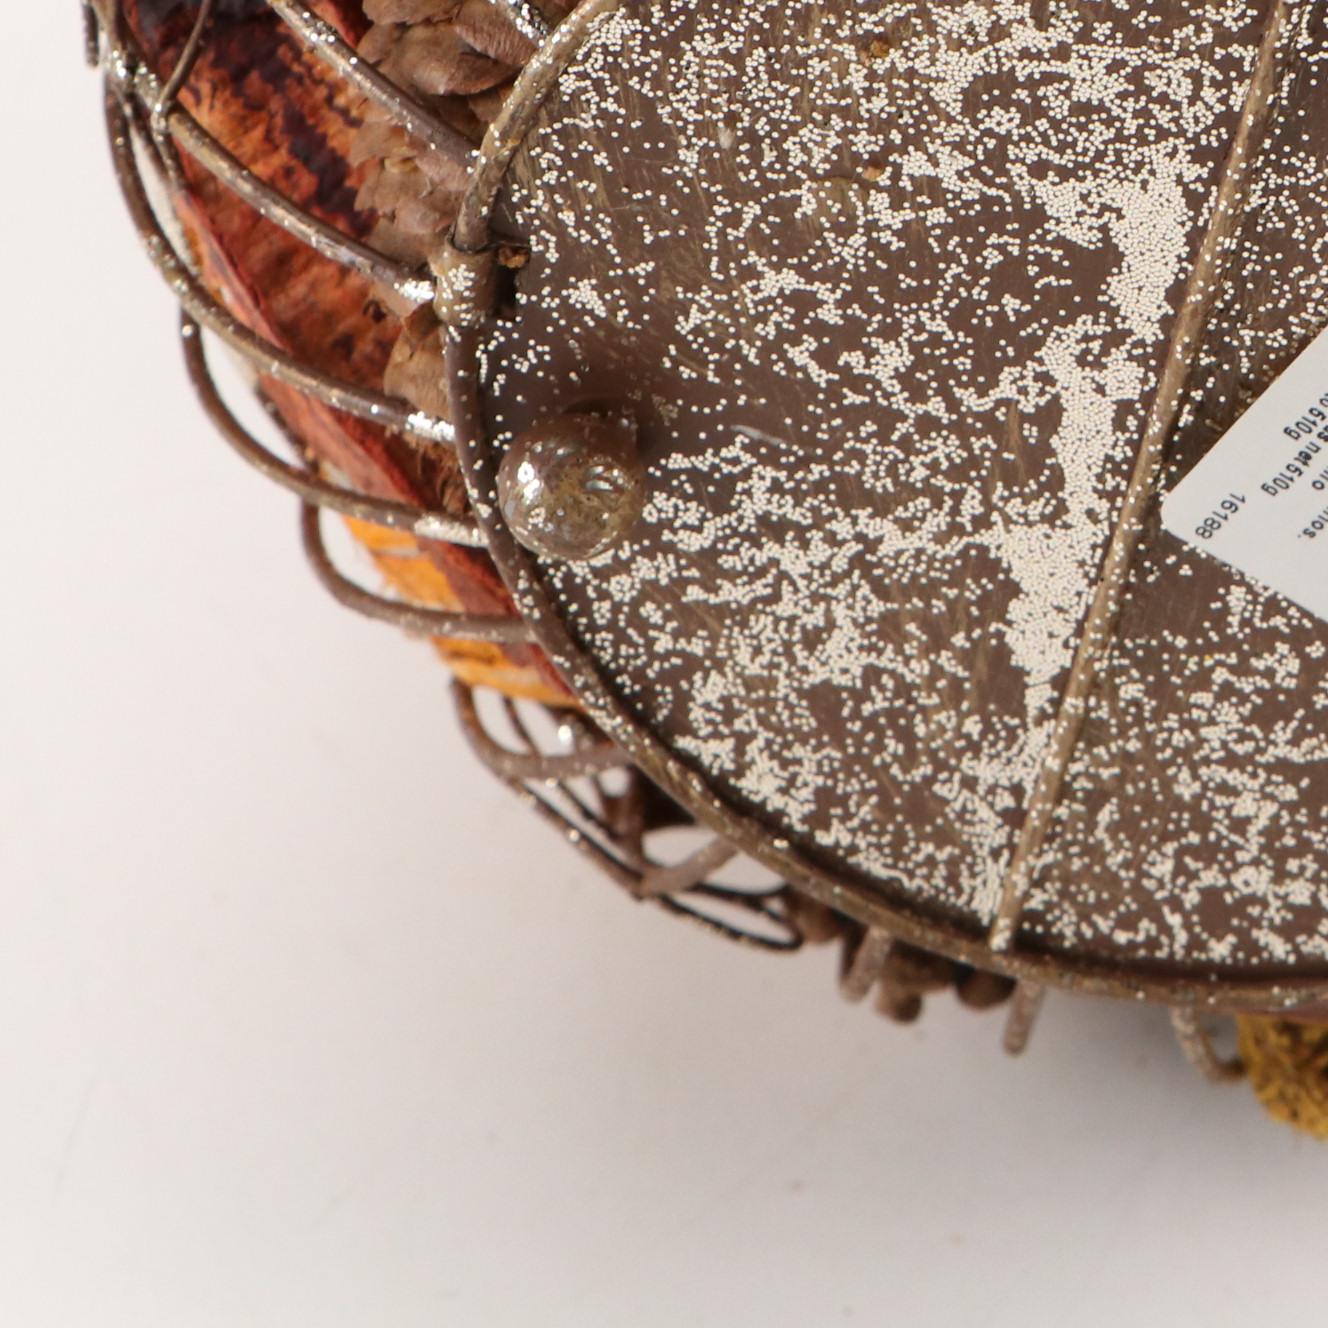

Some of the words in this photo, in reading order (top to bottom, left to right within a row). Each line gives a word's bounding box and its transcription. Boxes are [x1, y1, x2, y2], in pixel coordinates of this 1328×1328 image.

[1281, 404, 1328, 444] 510g
[1293, 439, 1322, 468] net
[1259, 460, 1305, 499] 510g
[1193, 490, 1247, 542] 16188
